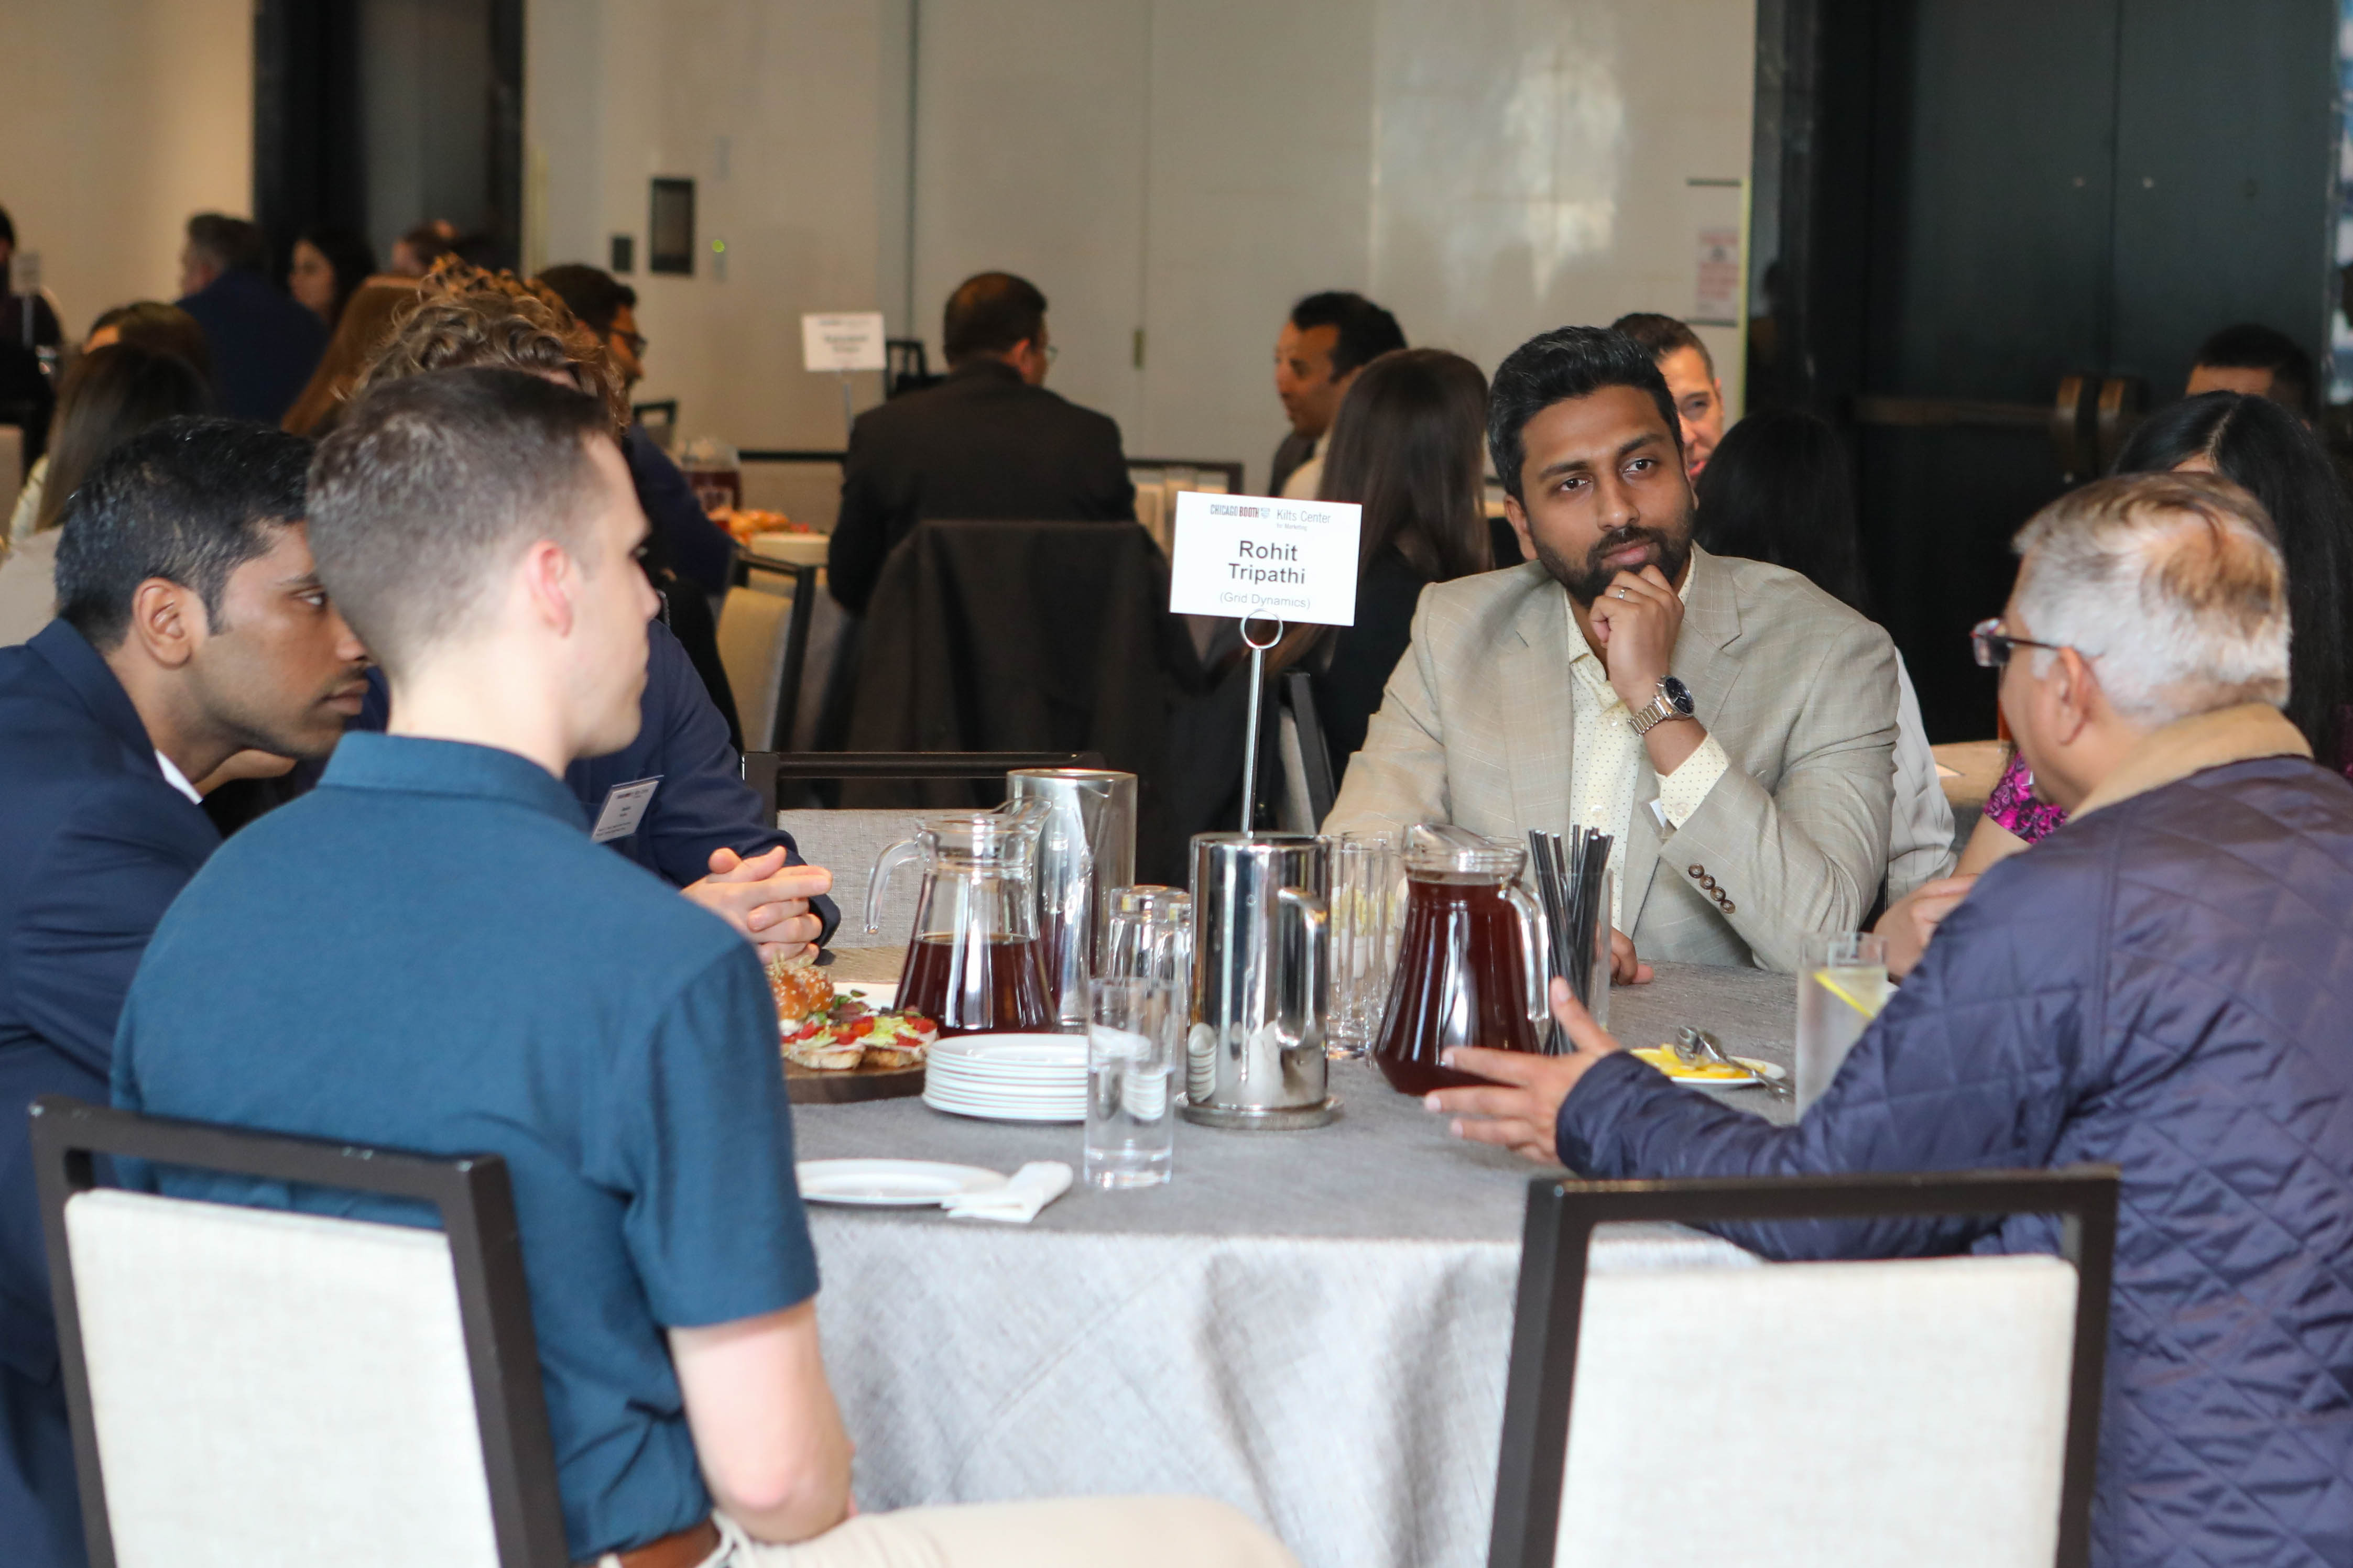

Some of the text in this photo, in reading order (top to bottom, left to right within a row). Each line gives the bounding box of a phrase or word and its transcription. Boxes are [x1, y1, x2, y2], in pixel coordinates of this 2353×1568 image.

[1210, 504, 1331, 524] CHICAGO BOOTH Kilts Center
[1239, 540, 1298, 561] Rohit
[1228, 563, 1305, 585] Tripathi
[1251, 594, 1311, 609] Dynamics)
